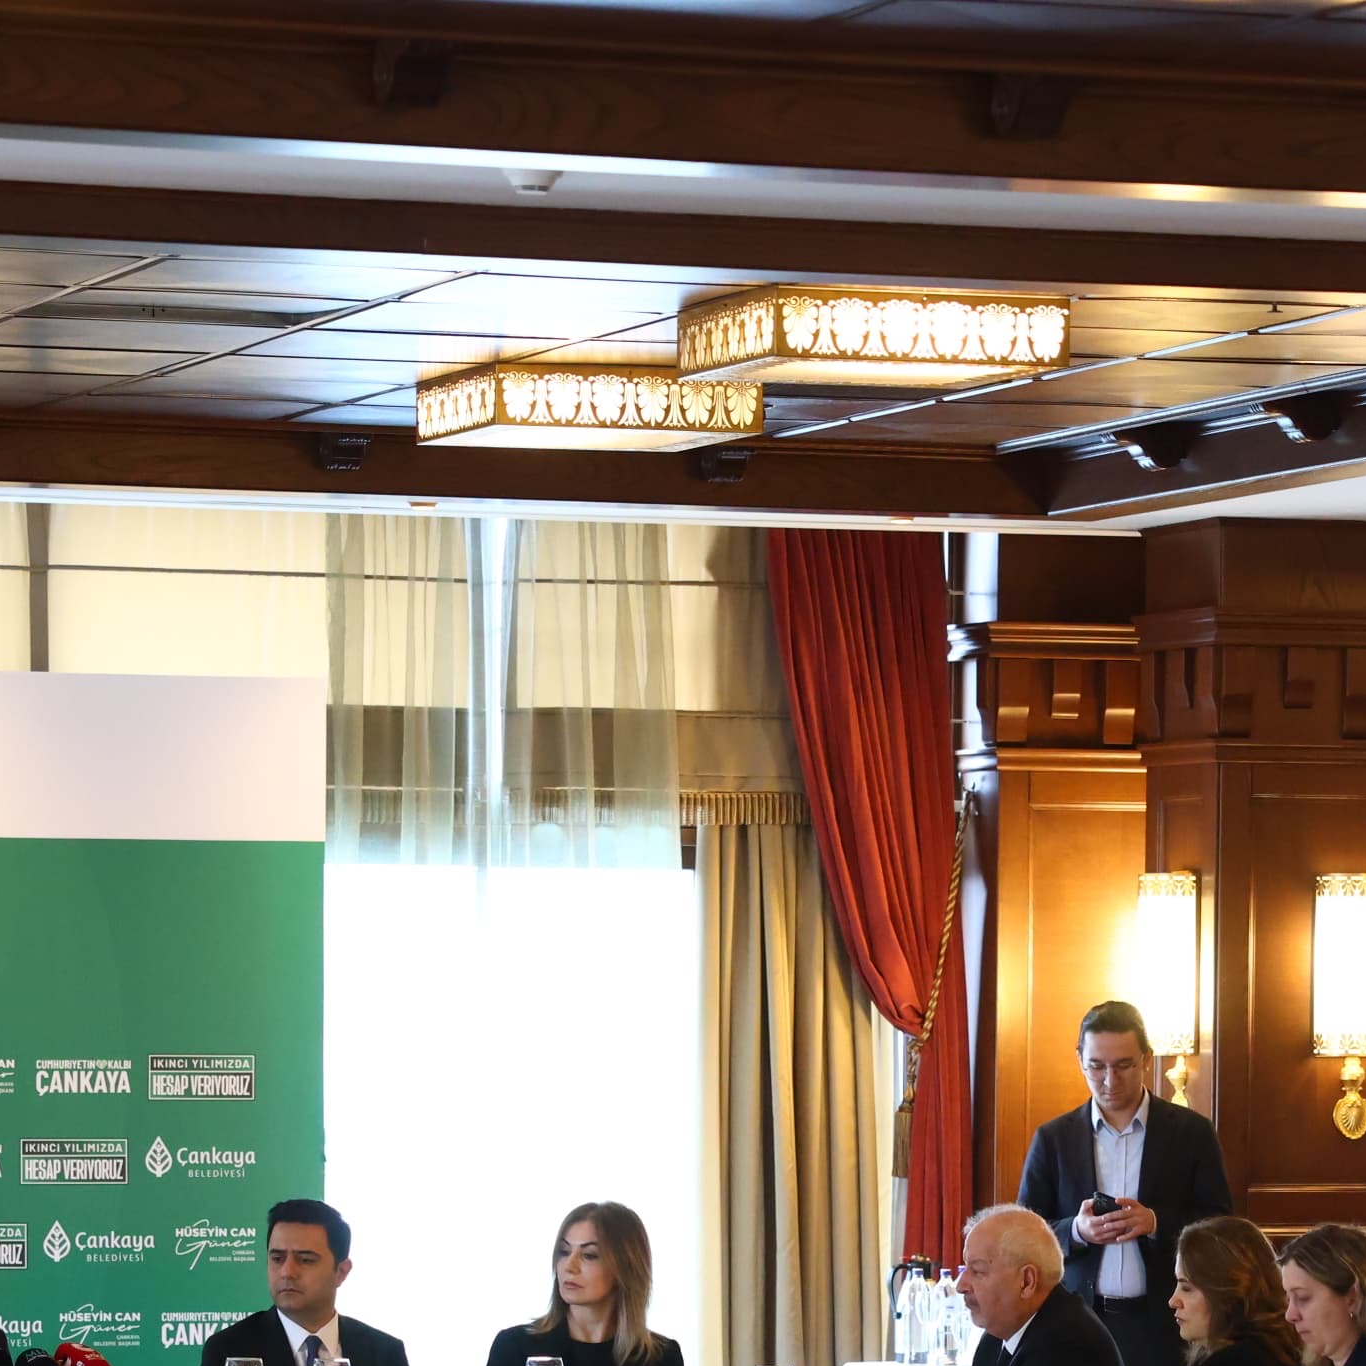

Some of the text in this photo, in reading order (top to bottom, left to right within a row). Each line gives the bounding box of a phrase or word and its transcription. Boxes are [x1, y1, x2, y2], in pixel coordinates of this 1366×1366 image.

[192, 1059, 250, 1069] YILIMIZDA
[36, 1070, 131, 1096] ÇANKAYA
[153, 1075, 189, 1095] HESAP
[64, 1143, 123, 1153] YILIMIZDA
[177, 1146, 256, 1168] Çankaya
[25, 1159, 61, 1180] HESAP
[188, 1167, 245, 1178] BELEDİYESİ
[175, 1226, 256, 1237] HÜSEYİN CAN
[75, 1231, 155, 1252] Çankaya
[86, 1252, 144, 1262] BELEDİYESİ
[59, 1311, 141, 1322] HÜSEYİN CAN
